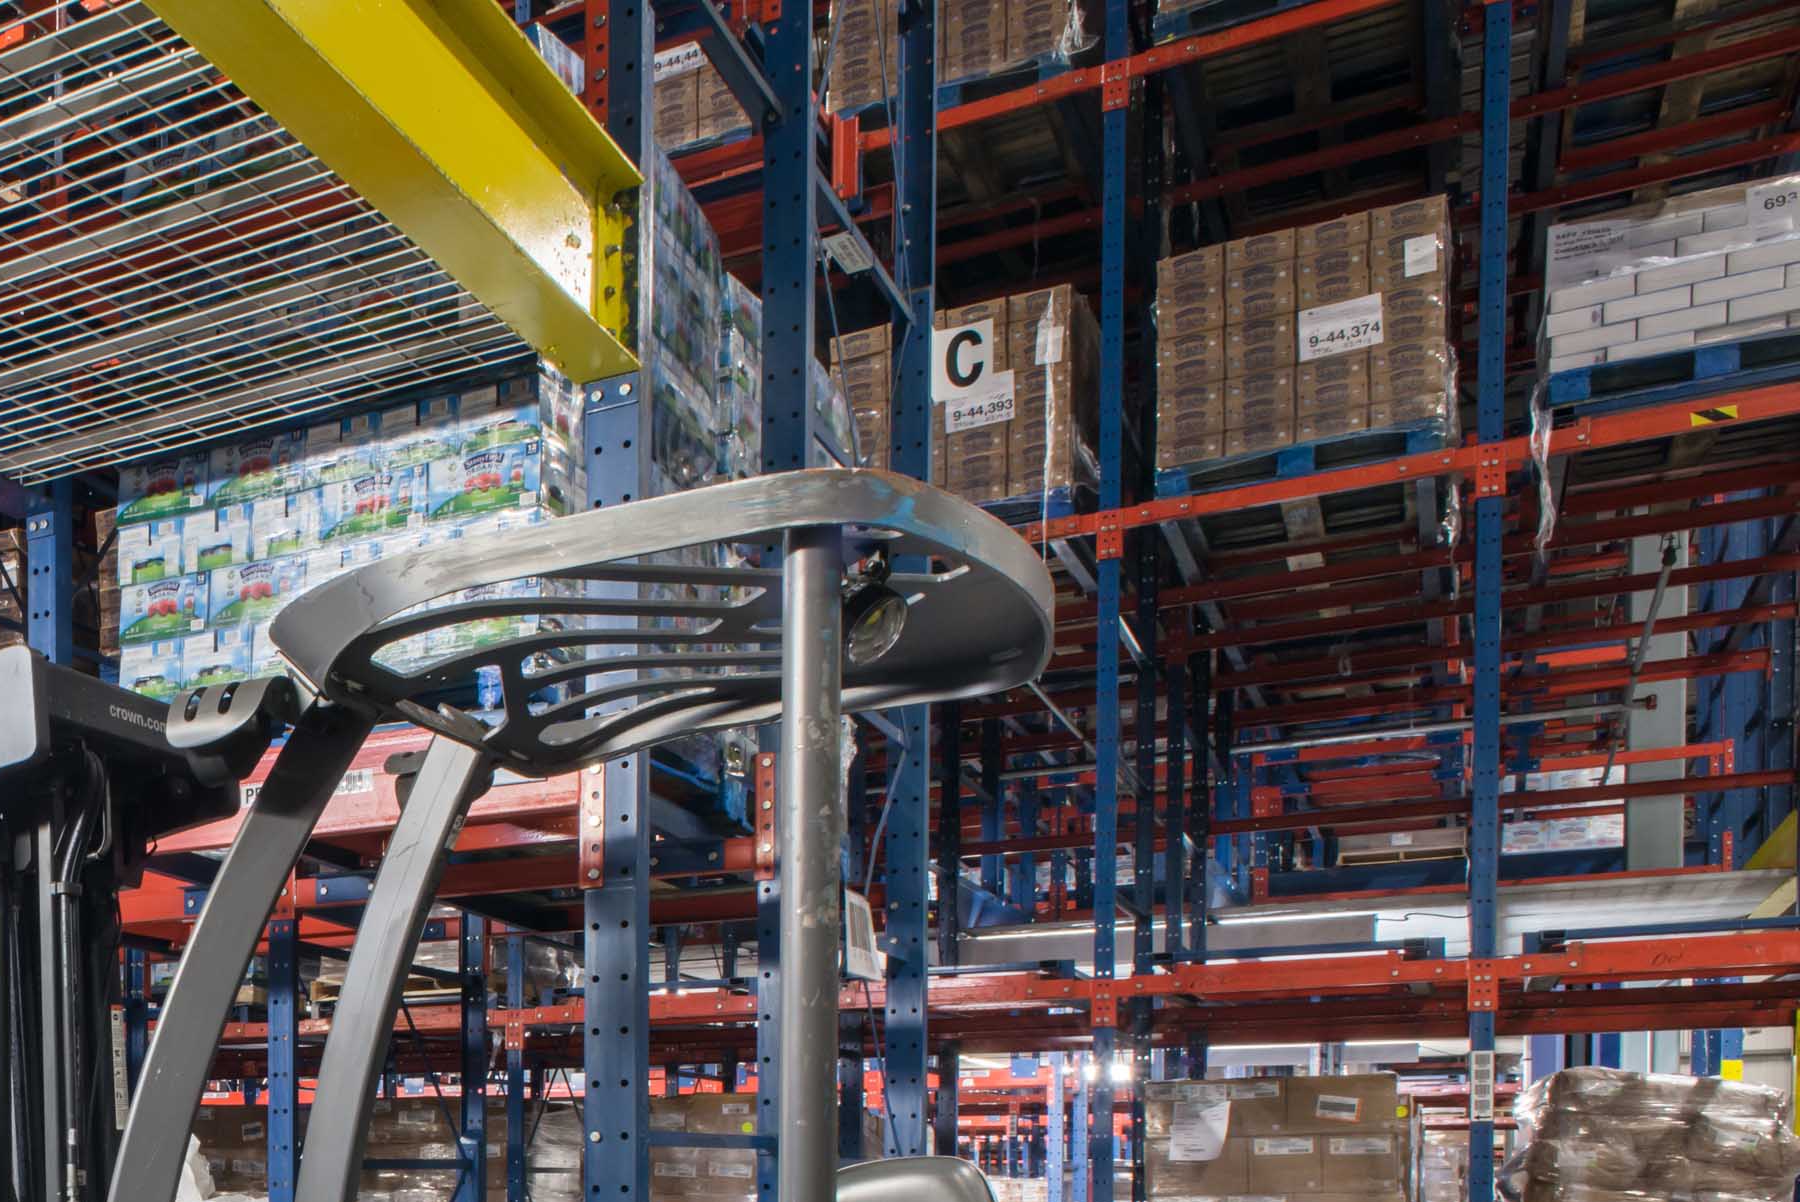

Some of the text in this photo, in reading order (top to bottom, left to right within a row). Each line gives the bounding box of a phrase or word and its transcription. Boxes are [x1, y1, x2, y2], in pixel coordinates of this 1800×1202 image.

[655, 48, 703, 72] 9-44,44
[1309, 321, 1381, 348] 9-44,374
[946, 330, 984, 388] C
[953, 398, 1013, 421] 9-44,393
